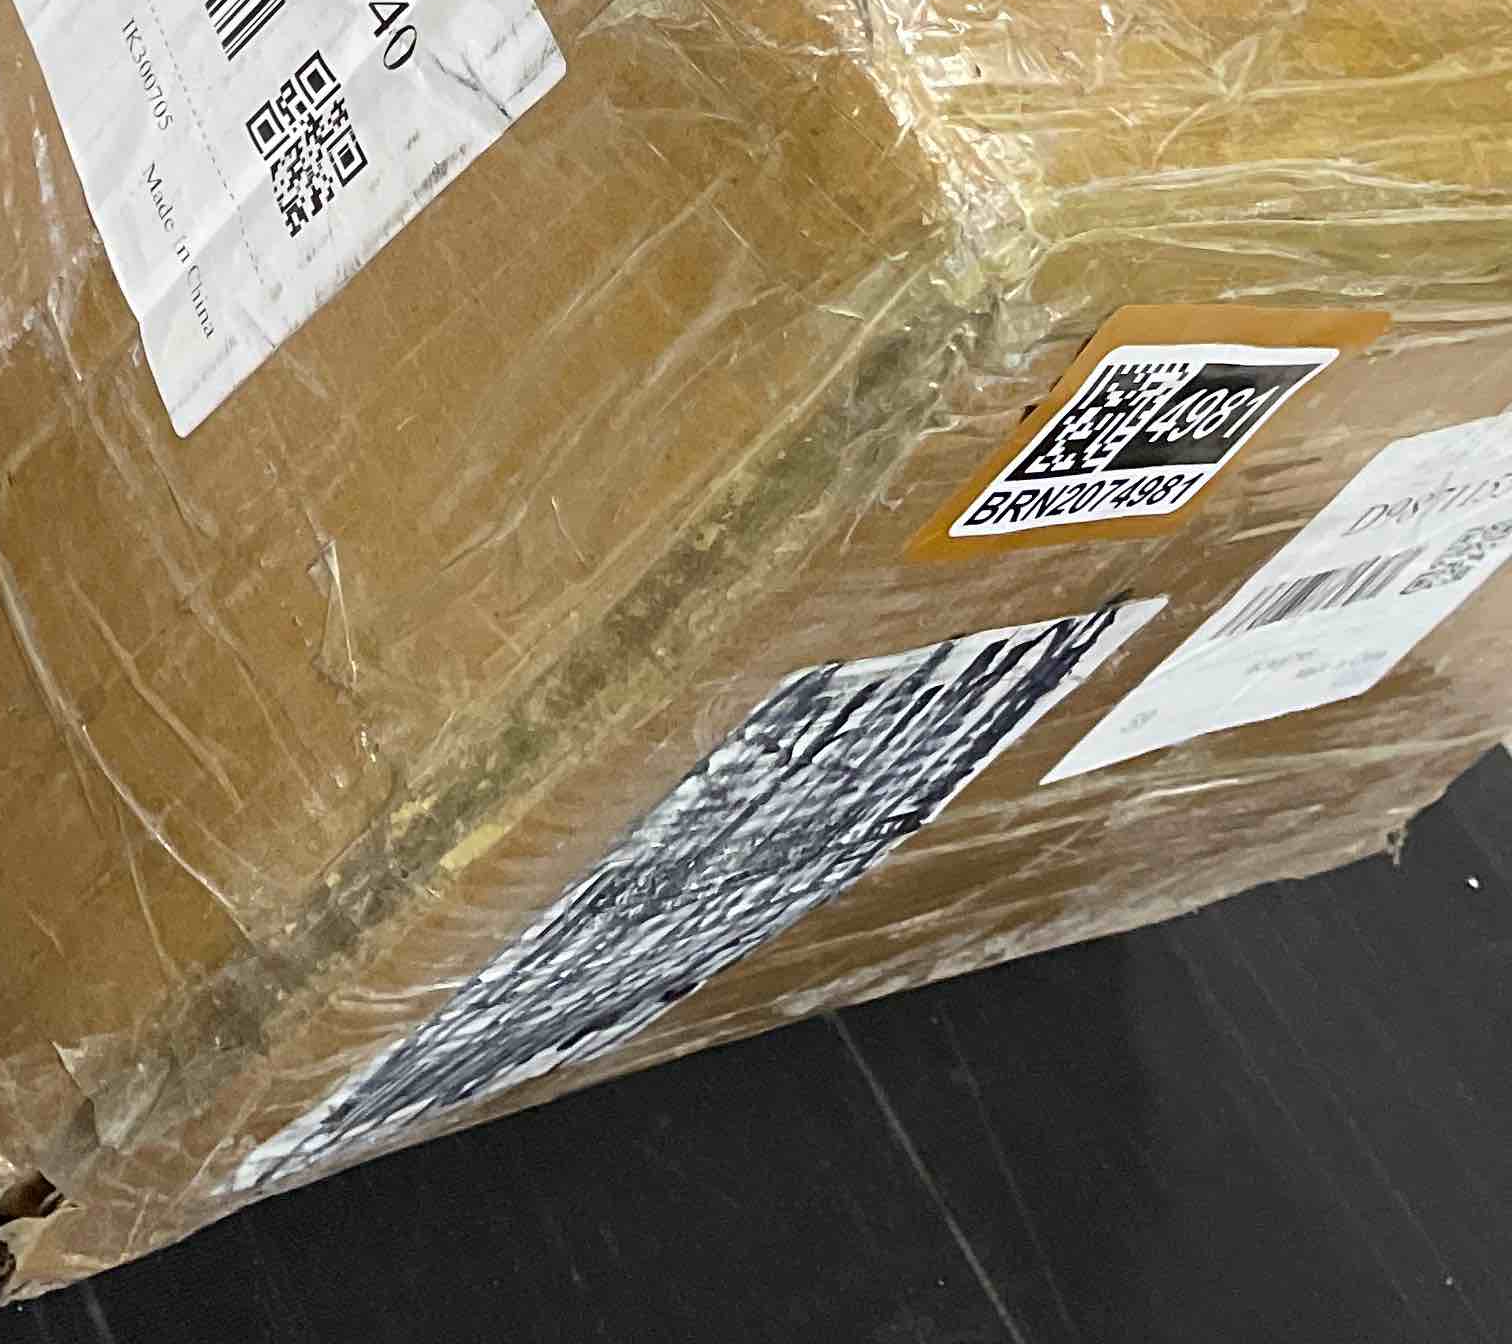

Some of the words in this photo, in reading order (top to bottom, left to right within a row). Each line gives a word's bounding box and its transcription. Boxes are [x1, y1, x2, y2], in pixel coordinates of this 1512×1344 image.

[142, 161, 175, 233] Made
[187, 263, 216, 340] China
[1144, 384, 1281, 444] 4981
[963, 472, 1205, 527] BRN2074981
